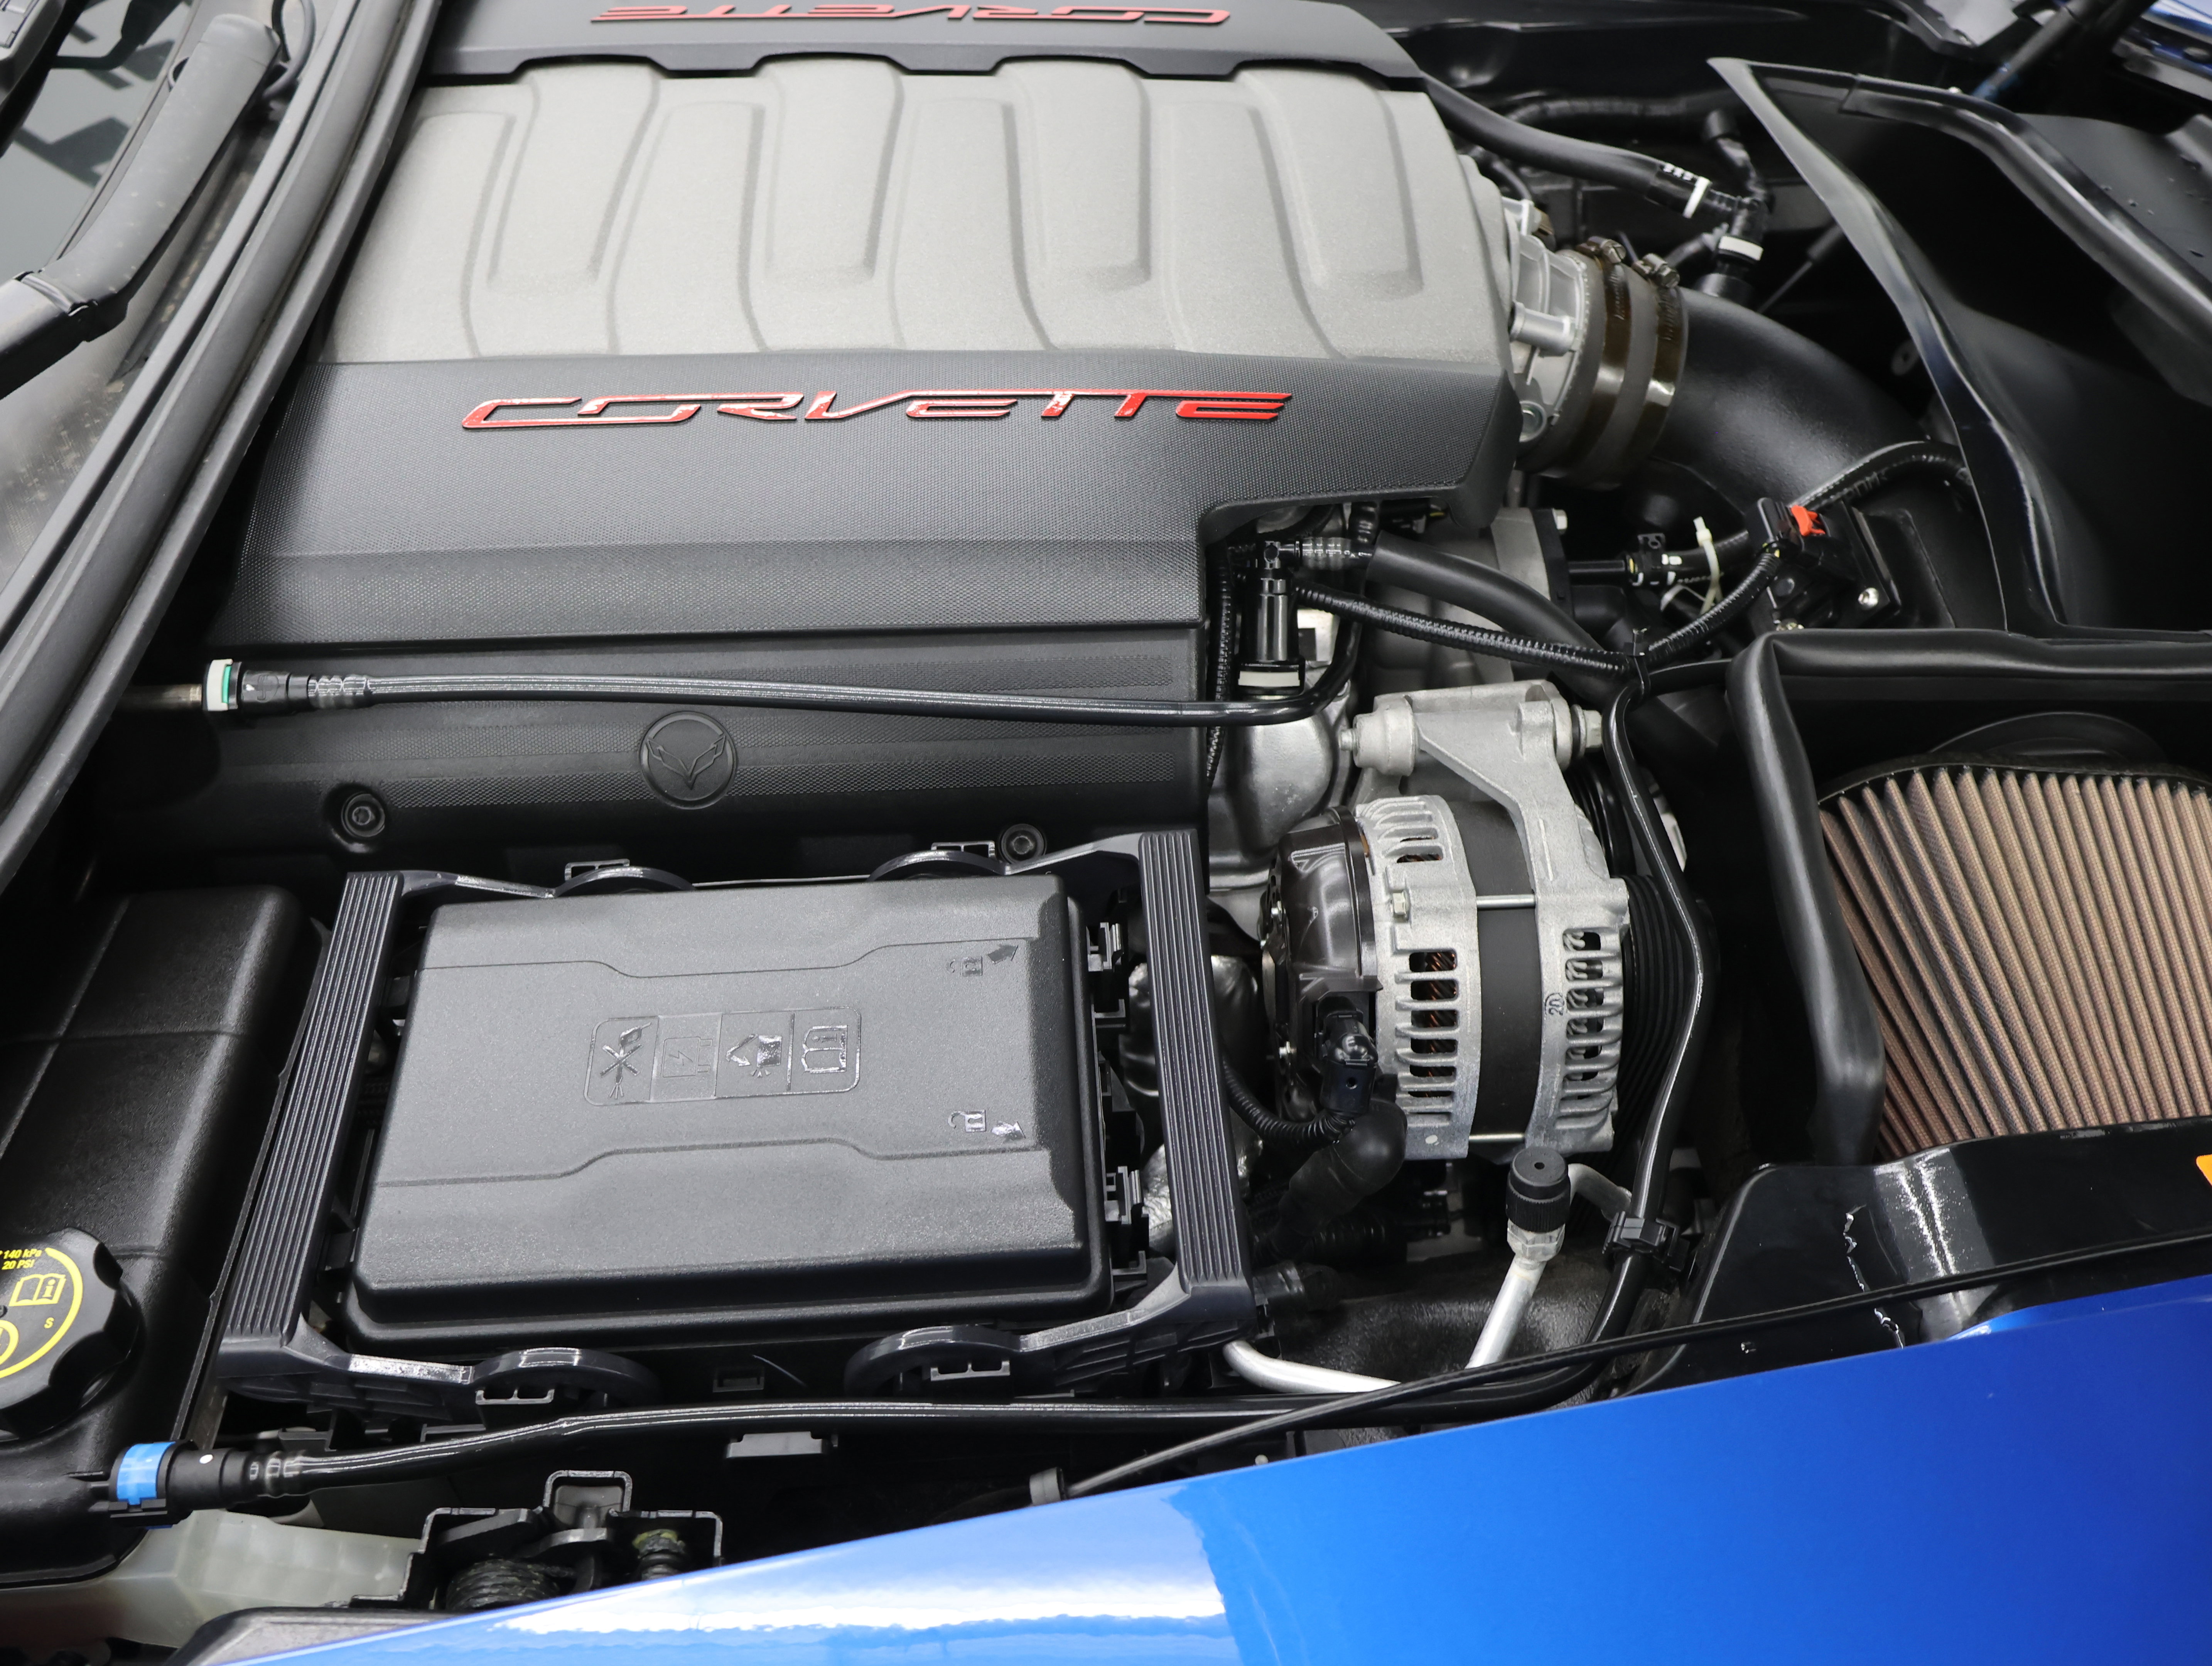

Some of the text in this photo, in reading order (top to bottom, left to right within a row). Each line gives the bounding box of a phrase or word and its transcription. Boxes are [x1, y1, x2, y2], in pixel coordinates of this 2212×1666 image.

[591, 4, 1231, 24] CORVETTE
[461, 388, 1292, 430] CORVETTE
[3, 1250, 22, 1259] 140
[22, 1248, 42, 1258] kPa
[2, 1259, 35, 1270] 20 PSI
